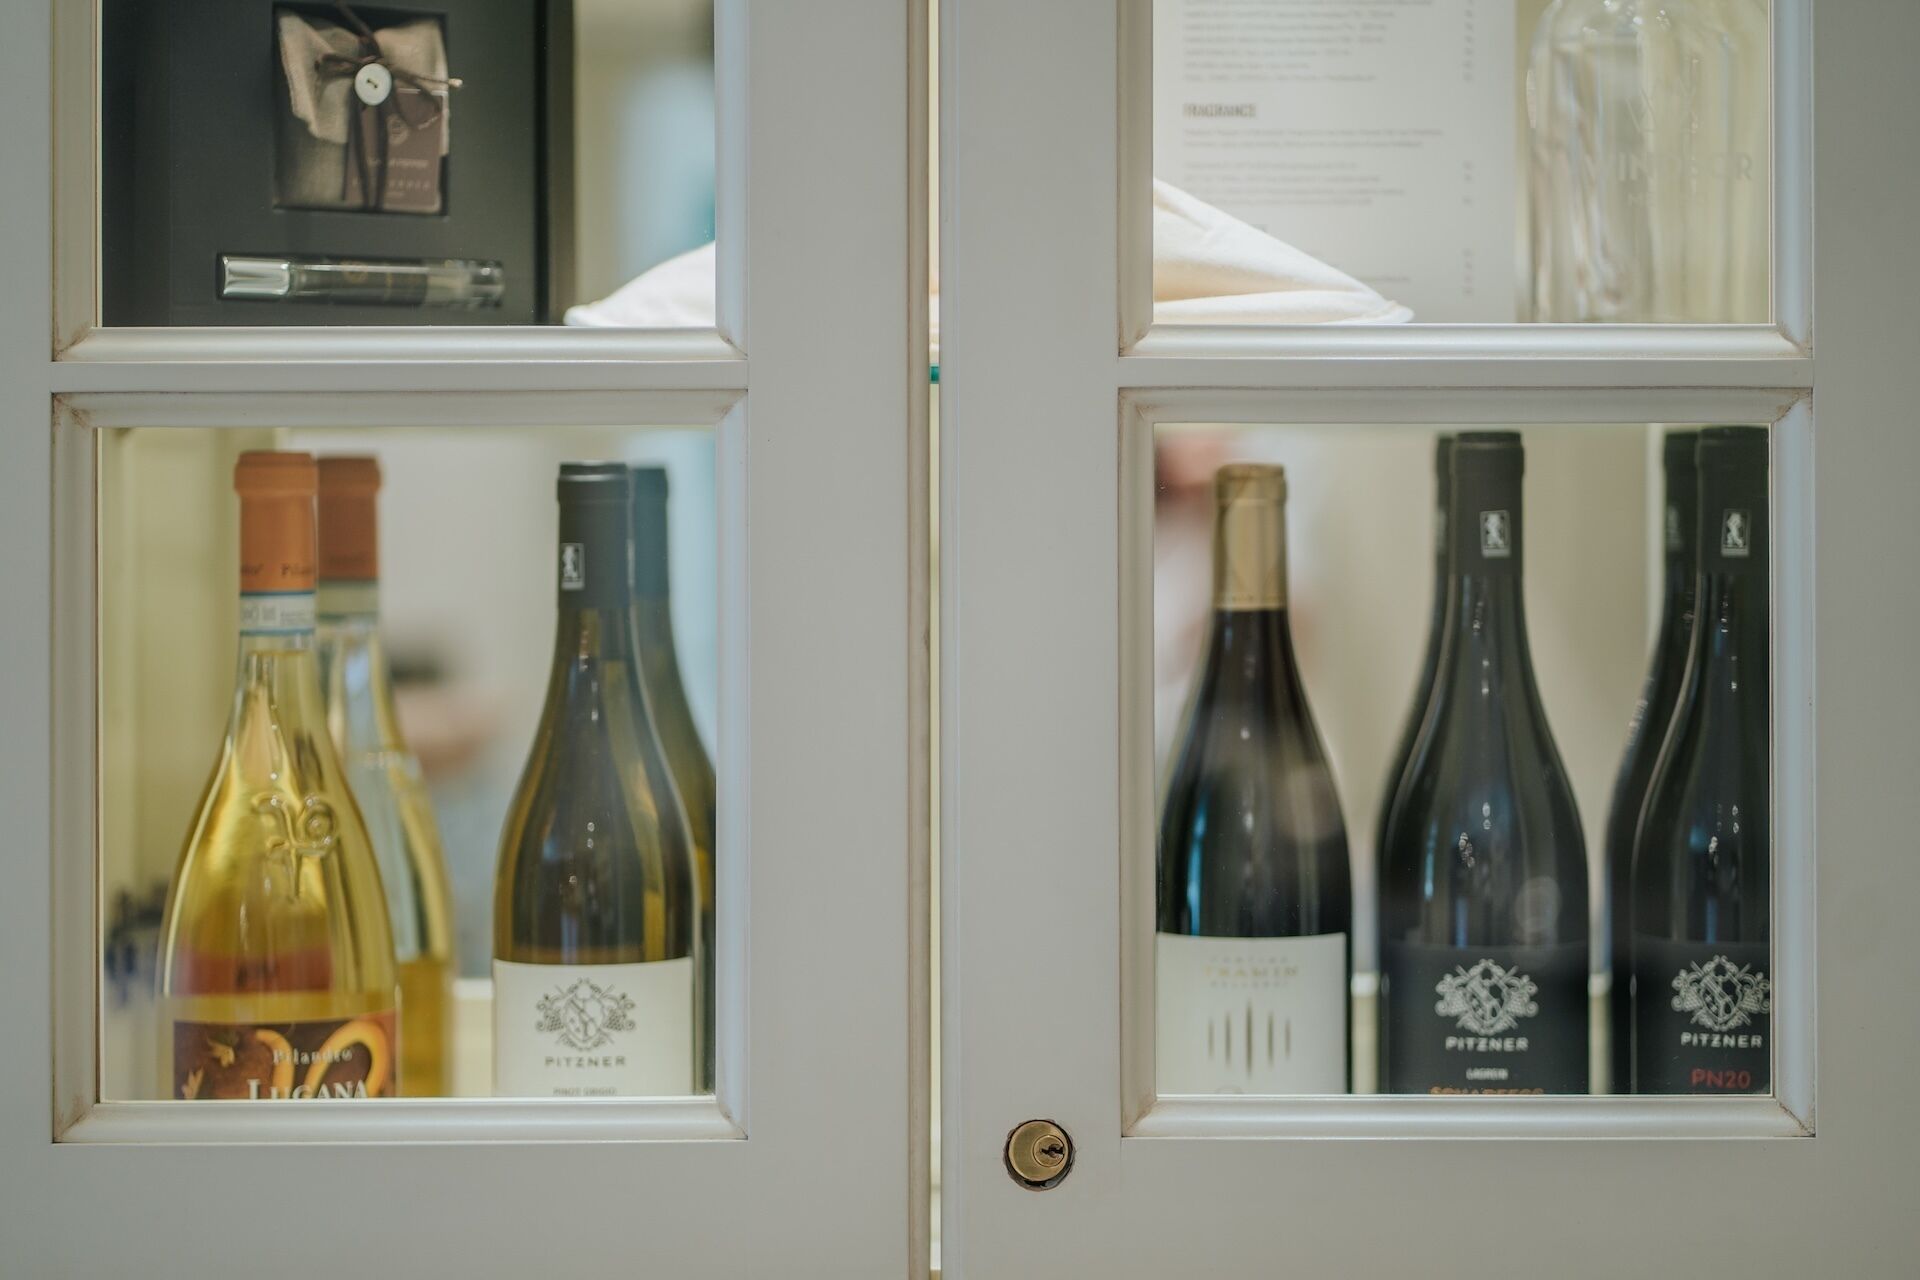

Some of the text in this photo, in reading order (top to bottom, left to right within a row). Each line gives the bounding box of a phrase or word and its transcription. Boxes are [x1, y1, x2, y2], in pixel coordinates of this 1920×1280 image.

[1445, 1036, 1529, 1052] PITZNER
[1680, 1032, 1763, 1048] PITZNER
[544, 1055, 626, 1068] PITZNER
[1690, 1068, 1752, 1089] PN20
